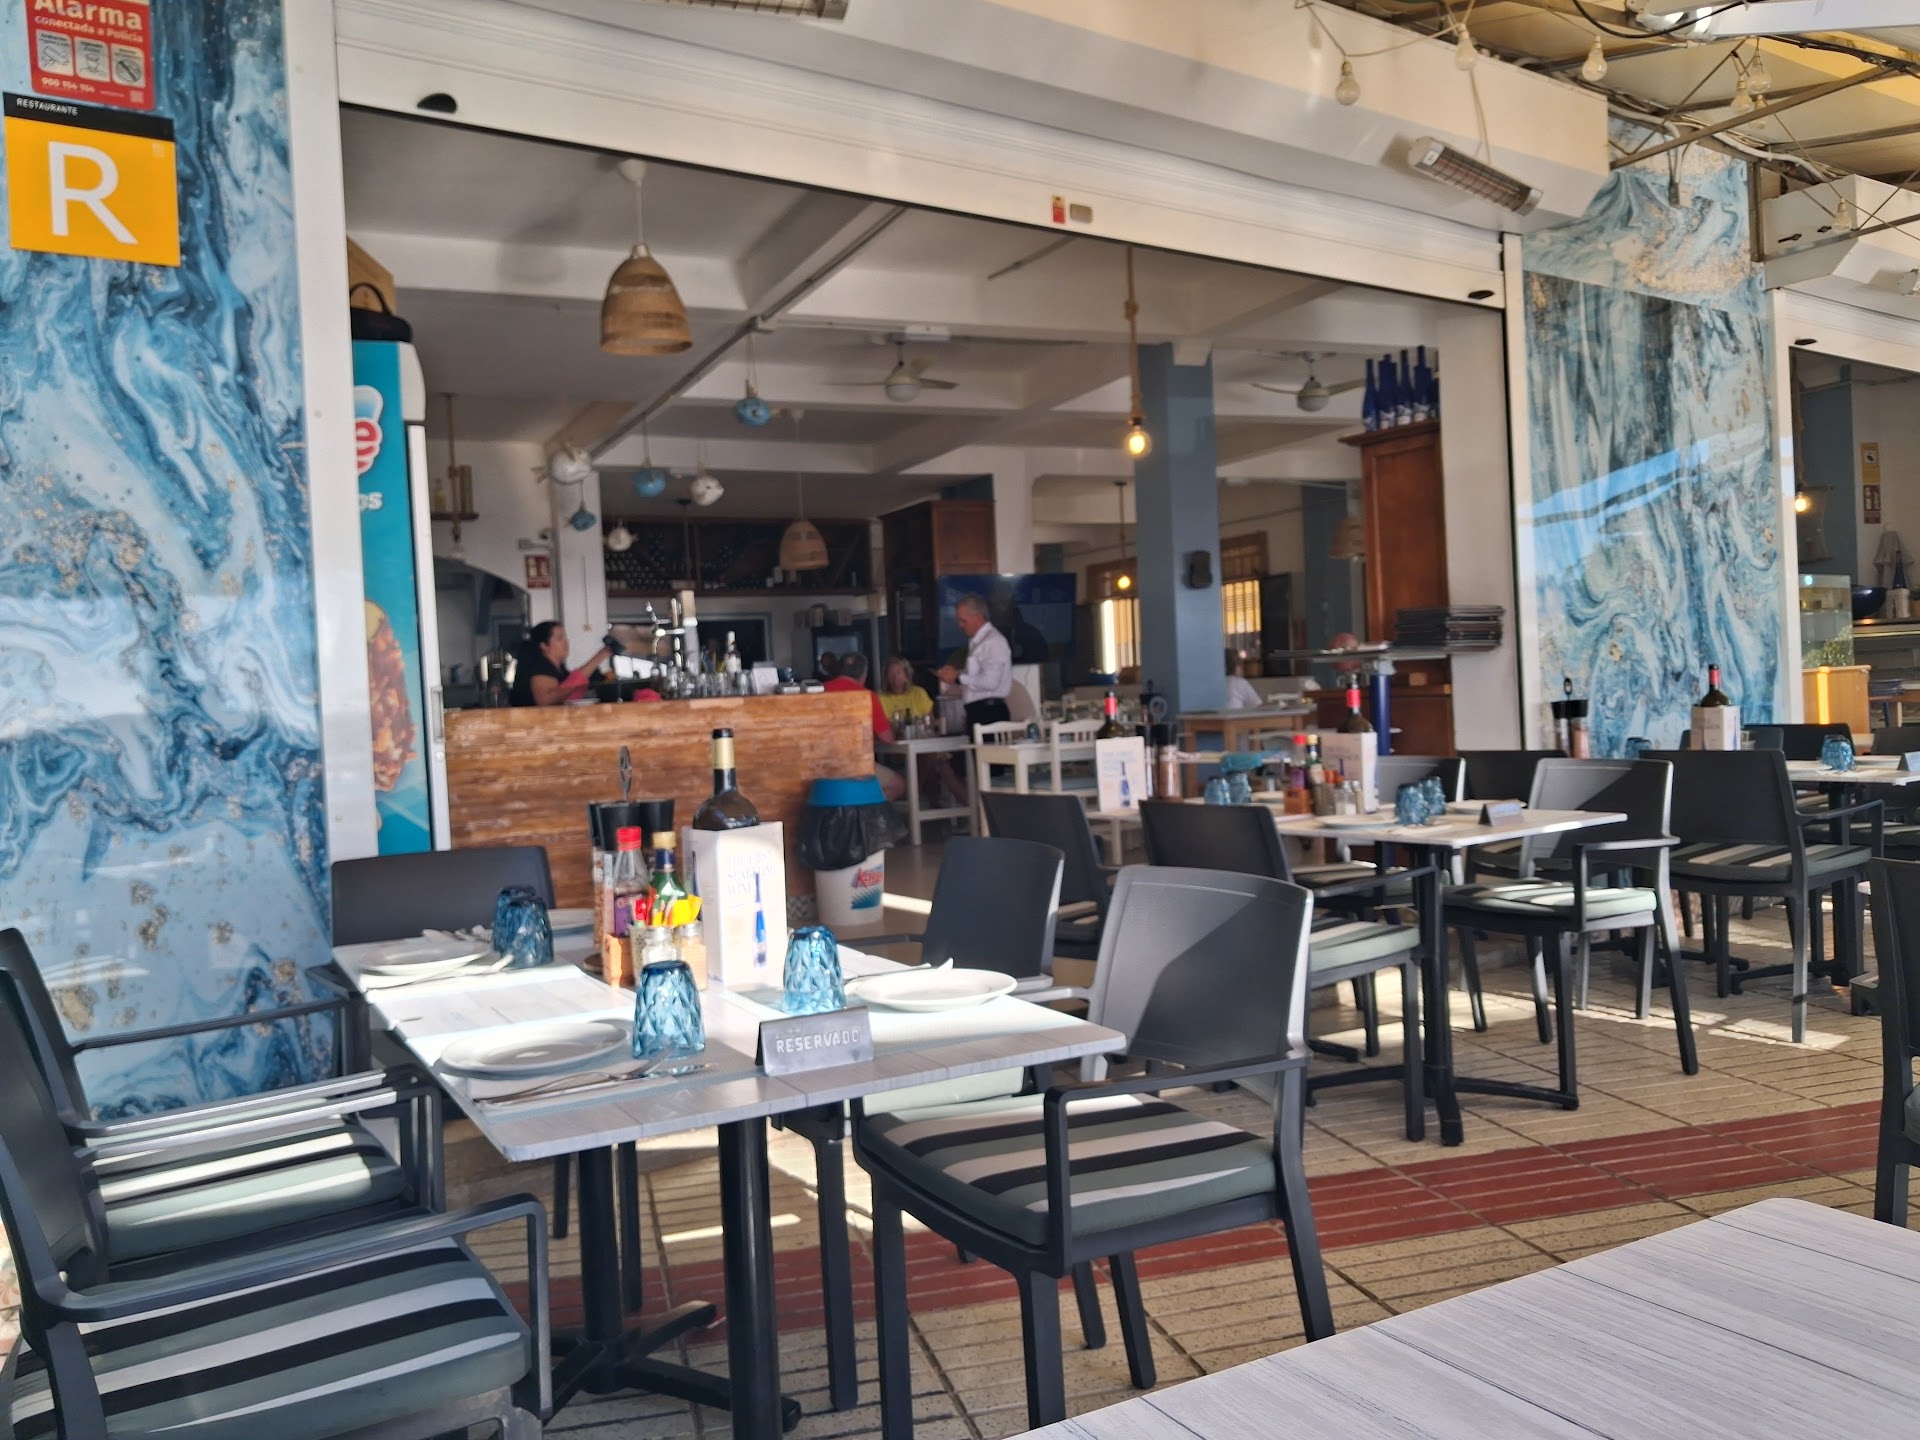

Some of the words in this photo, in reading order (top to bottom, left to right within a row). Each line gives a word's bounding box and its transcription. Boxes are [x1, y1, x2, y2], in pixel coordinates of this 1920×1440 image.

[34, 0, 143, 30] Alarma
[34, 15, 96, 34] conectada
[15, 97, 79, 116] RESTAURANTE
[48, 141, 139, 245] R
[776, 1028, 860, 1054] RESERVADO
